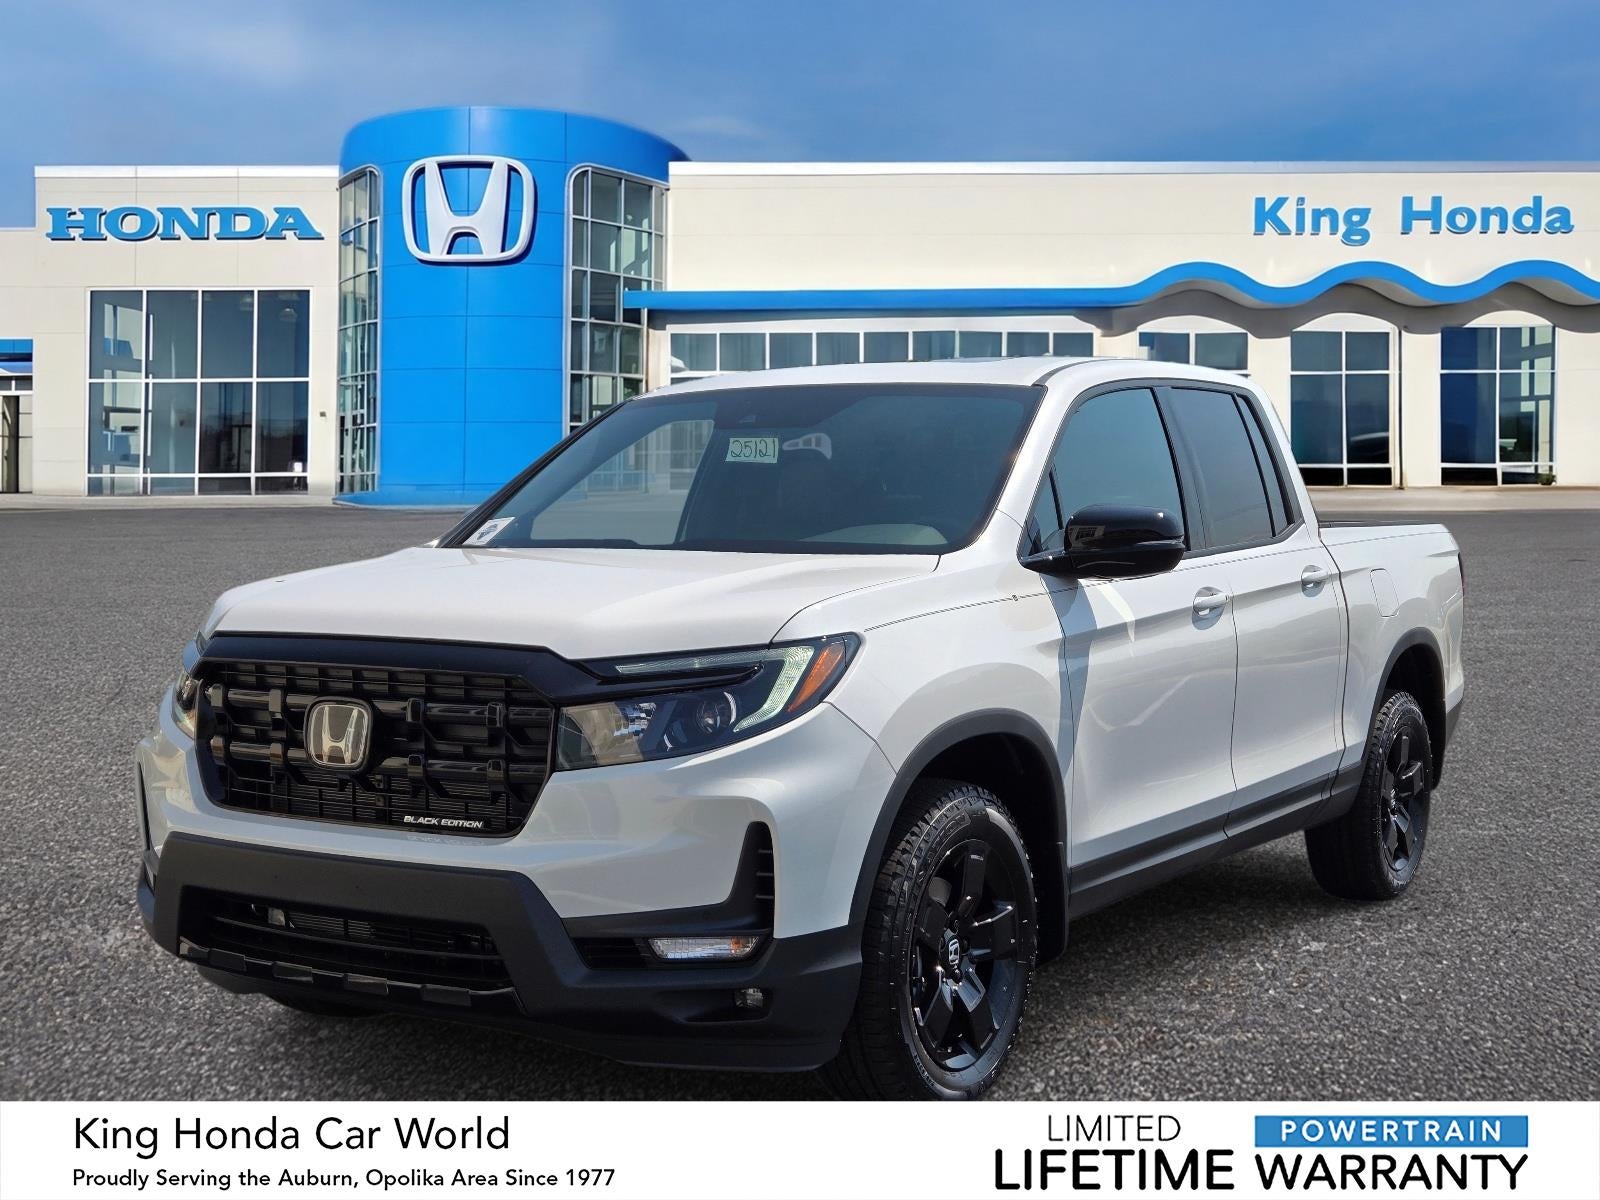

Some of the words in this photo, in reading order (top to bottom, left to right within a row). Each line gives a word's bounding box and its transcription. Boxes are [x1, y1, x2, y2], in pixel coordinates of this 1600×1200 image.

[46, 205, 326, 242] HONDA
[1253, 196, 1373, 247] King
[1400, 195, 1575, 235] Honda
[730, 438, 776, 458] 25121
[403, 815, 439, 826] BLACK
[440, 818, 483, 829] EDITION
